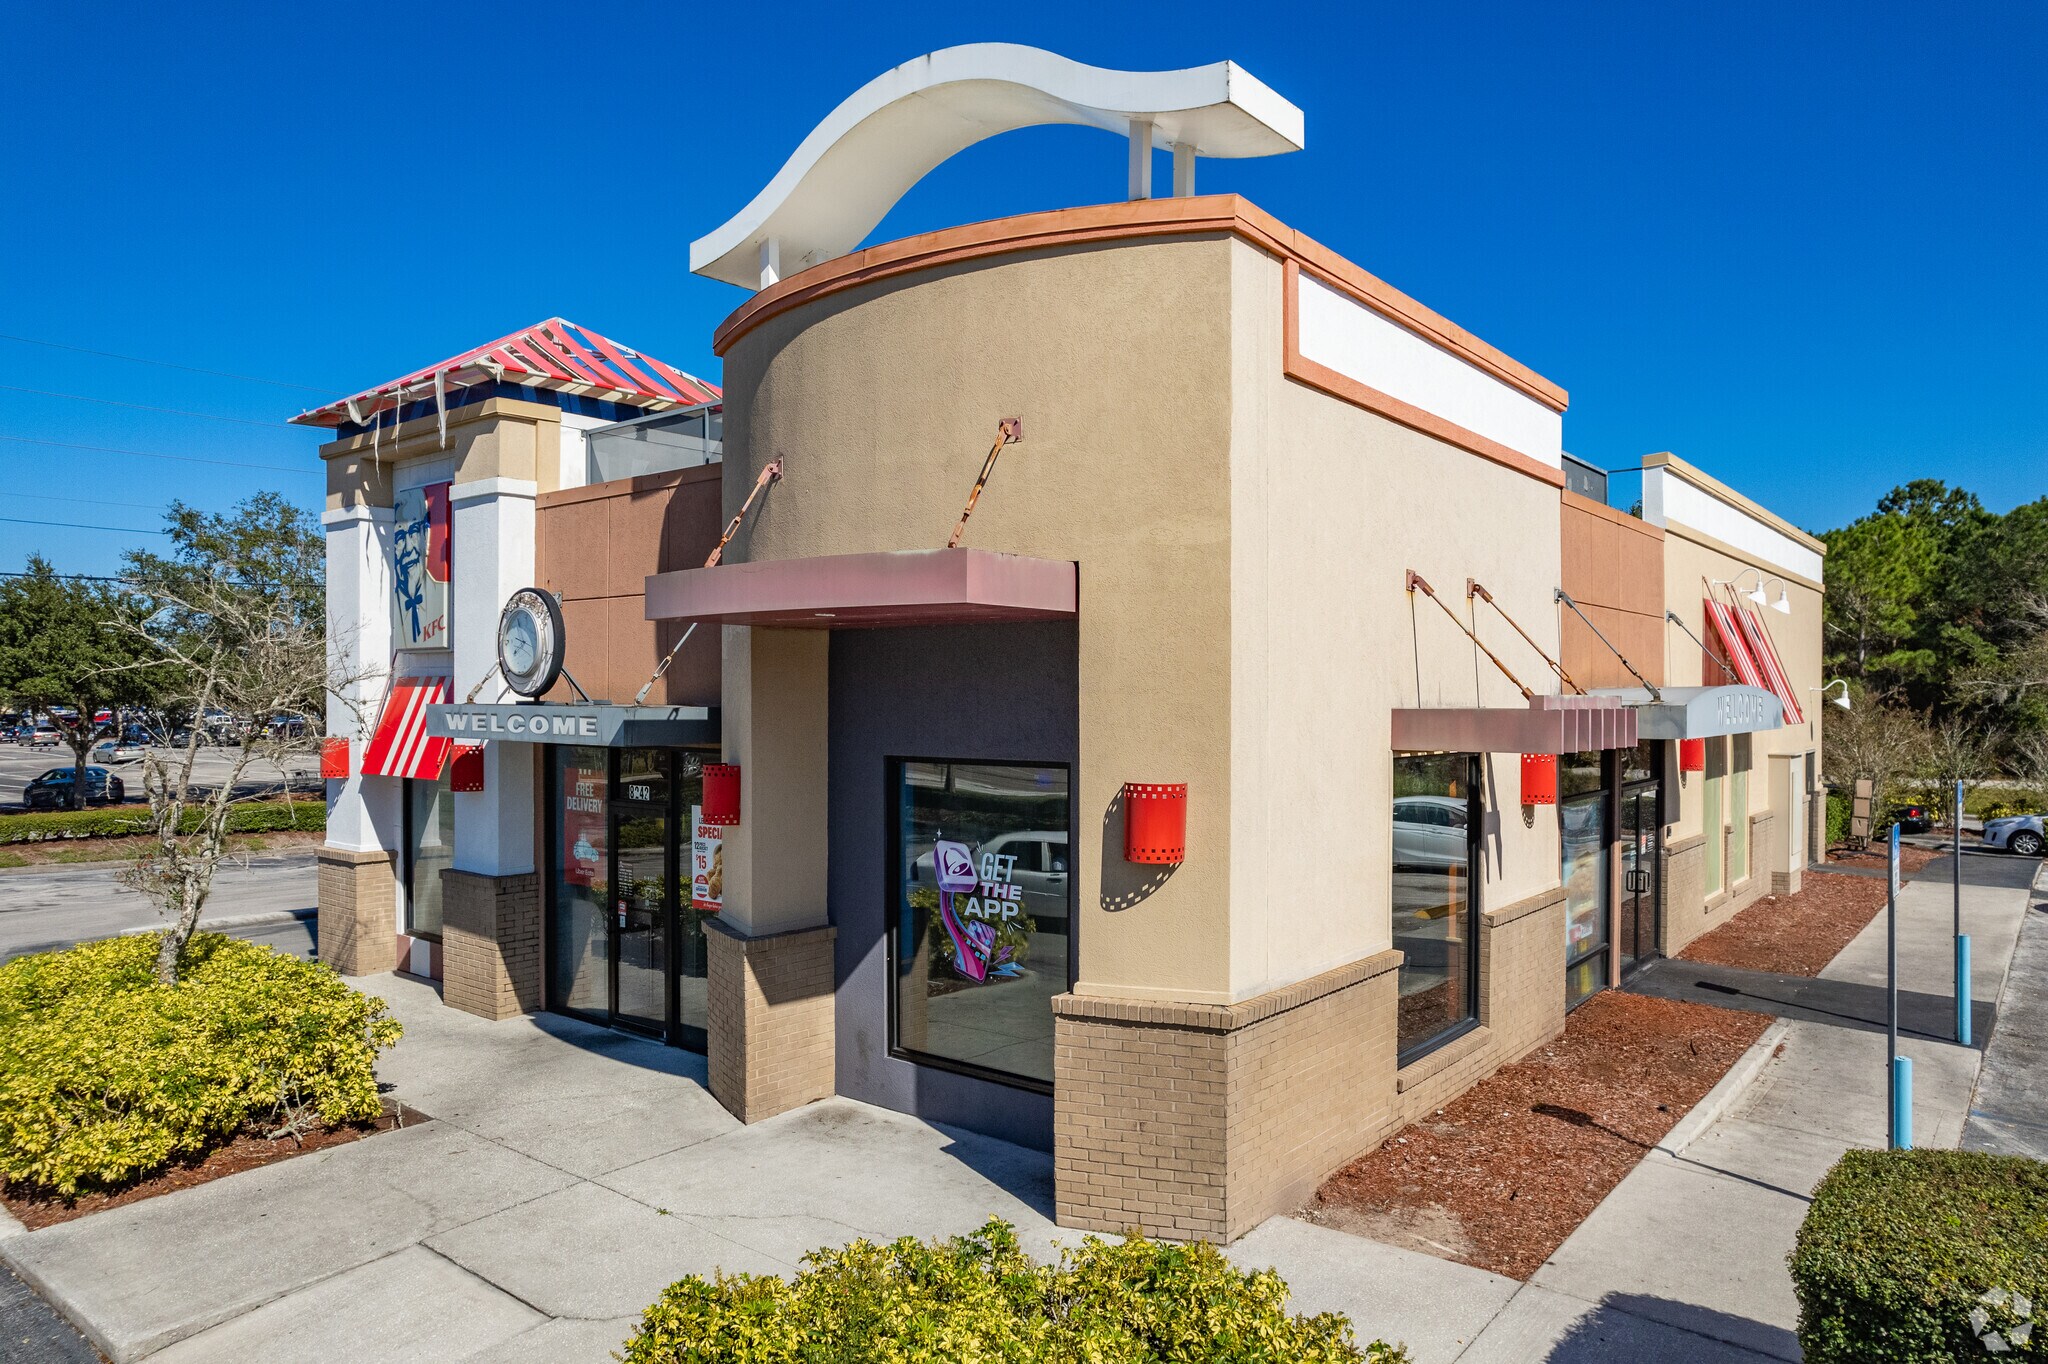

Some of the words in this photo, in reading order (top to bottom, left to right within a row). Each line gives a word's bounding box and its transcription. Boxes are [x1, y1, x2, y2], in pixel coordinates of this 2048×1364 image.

[422, 614, 446, 642] KFC
[1717, 693, 1764, 727] WELCOME
[445, 711, 598, 737] WELCOME
[575, 782, 594, 797] FREE
[566, 796, 603, 814] DELIVERY
[980, 852, 1018, 883] GET
[979, 881, 1023, 901] THE
[964, 897, 1019, 922] APP
